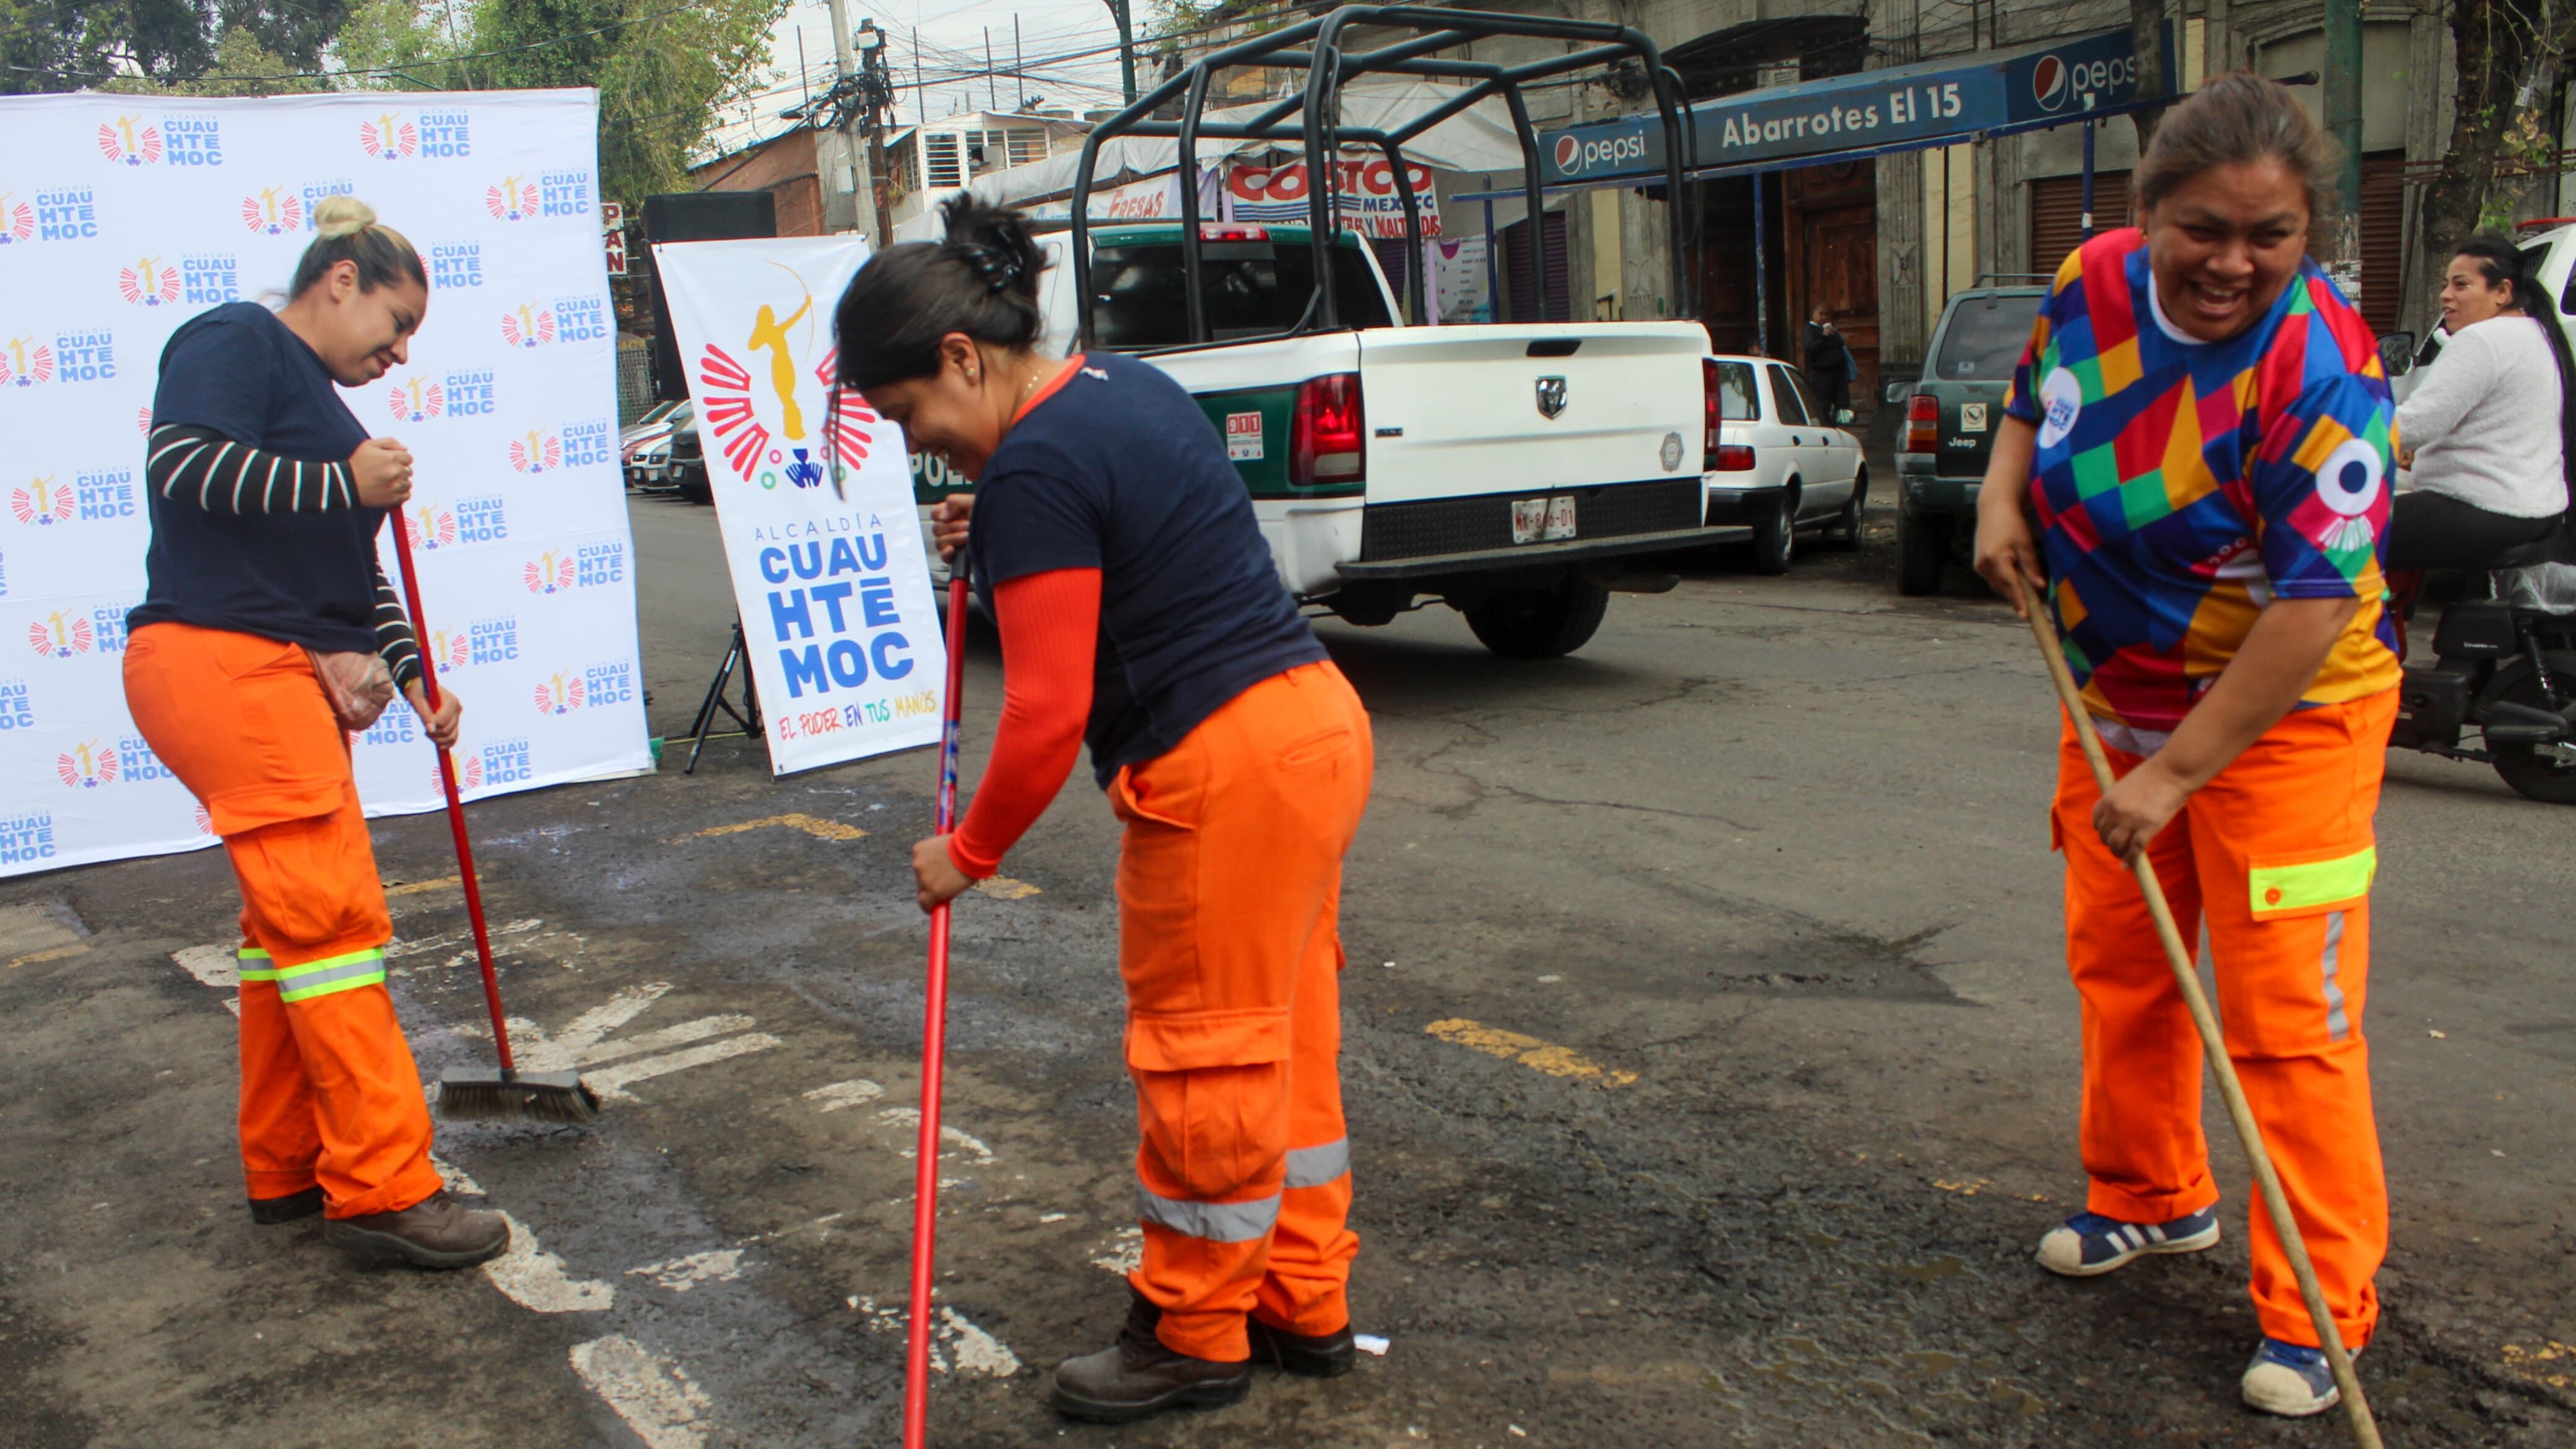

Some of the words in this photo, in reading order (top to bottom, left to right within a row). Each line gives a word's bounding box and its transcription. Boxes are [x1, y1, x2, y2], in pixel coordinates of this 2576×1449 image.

[2072, 56, 2136, 101] peps
[420, 115, 468, 126] CUAU
[1722, 106, 1879, 148] Abarrotes
[1889, 86, 1916, 124] El
[1926, 83, 1962, 119] 15
[164, 121, 218, 133] CUAU
[422, 143, 471, 158] MOC
[1585, 129, 1645, 169] pepsi
[168, 150, 223, 165] MOC
[542, 173, 587, 186] CUAU
[37, 191, 93, 206] CUAU
[303, 183, 353, 198] CUAU
[544, 201, 589, 217] MOC
[1108, 189, 1164, 218] FRESAS
[1364, 198, 1434, 212] MEXCO
[41, 222, 97, 242] MOC
[1375, 215, 1442, 238] MALTDAS
[604, 206, 624, 272] PAN
[432, 245, 479, 257] CUAU
[183, 259, 236, 271] CUAU
[435, 273, 482, 289] MOC
[186, 288, 240, 303] MOC
[555, 298, 601, 313] CUAU
[57, 333, 111, 349] CUAU
[560, 326, 606, 342] MOC
[60, 363, 116, 383] MOC
[446, 372, 494, 386] CUAU
[448, 400, 495, 417] MOC
[564, 422, 607, 438] CUAU
[1229, 417, 1258, 432] 911
[1948, 437, 1976, 448] Jeep
[565, 450, 609, 468] MOC
[908, 453, 973, 487] POL
[77, 471, 131, 487] CUAU
[80, 502, 135, 520] MOC
[456, 498, 502, 513] CUAU
[461, 526, 507, 544] MOC
[755, 513, 881, 541] ALCALDÍA
[578, 543, 622, 557] CUAU
[760, 533, 887, 584] CUAU
[579, 569, 623, 588] MOC
[95, 607, 131, 620] CU
[96, 620, 128, 637] HT
[471, 620, 516, 635] CUAU
[99, 636, 128, 653] MO
[472, 646, 518, 665] MOC
[587, 663, 629, 678] CUAU
[779, 631, 914, 698] MOC
[1, 684, 27, 697] AU
[589, 689, 632, 707] MOC
[388, 702, 411, 714] AU
[779, 716, 796, 741] EL
[799, 707, 843, 737] PODER
[843, 700, 863, 728] EN
[865, 699, 890, 723] TUS
[895, 690, 938, 718] MANOS
[0, 713, 34, 730] OC
[120, 739, 146, 751] CU
[366, 729, 414, 746] MOC
[484, 738, 528, 754] CUAU
[122, 750, 155, 767] HT
[487, 764, 531, 783] MOC
[0, 815, 51, 833] CUAU
[1, 843, 56, 864] MOC
